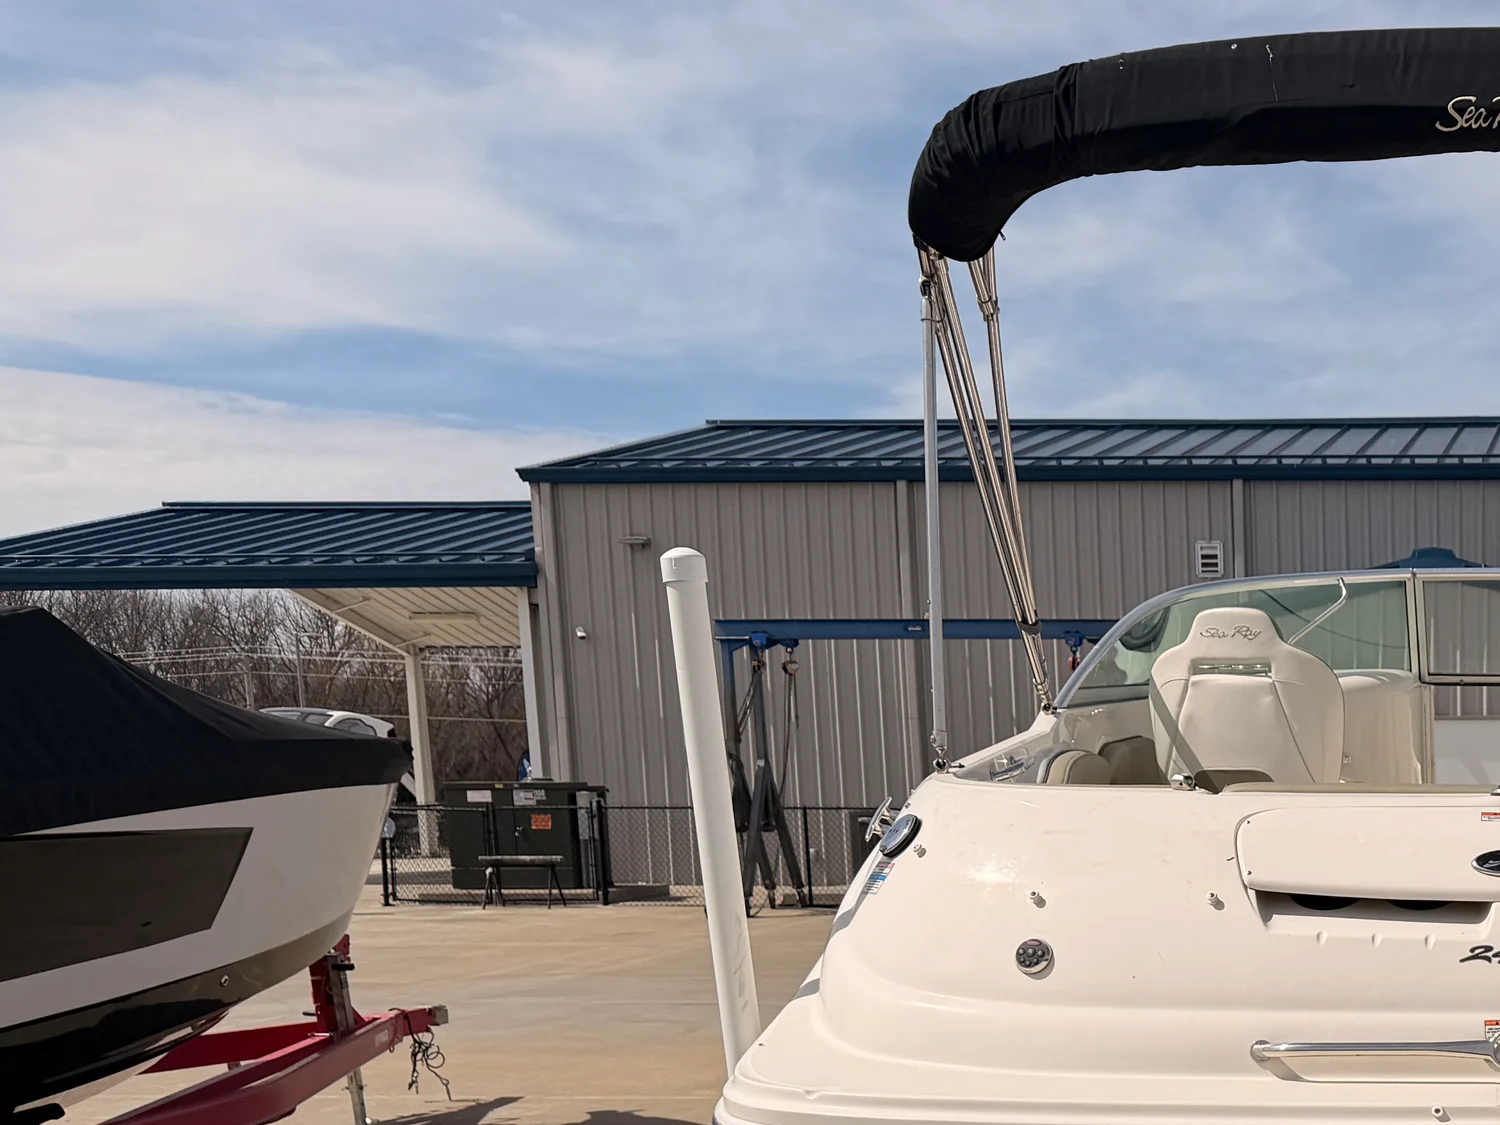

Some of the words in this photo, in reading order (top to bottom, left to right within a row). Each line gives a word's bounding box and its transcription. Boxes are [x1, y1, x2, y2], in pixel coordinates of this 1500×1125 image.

[1434, 95, 1492, 132] Sea
[1199, 627, 1228, 639] Sea
[1230, 625, 1262, 641] Ray
